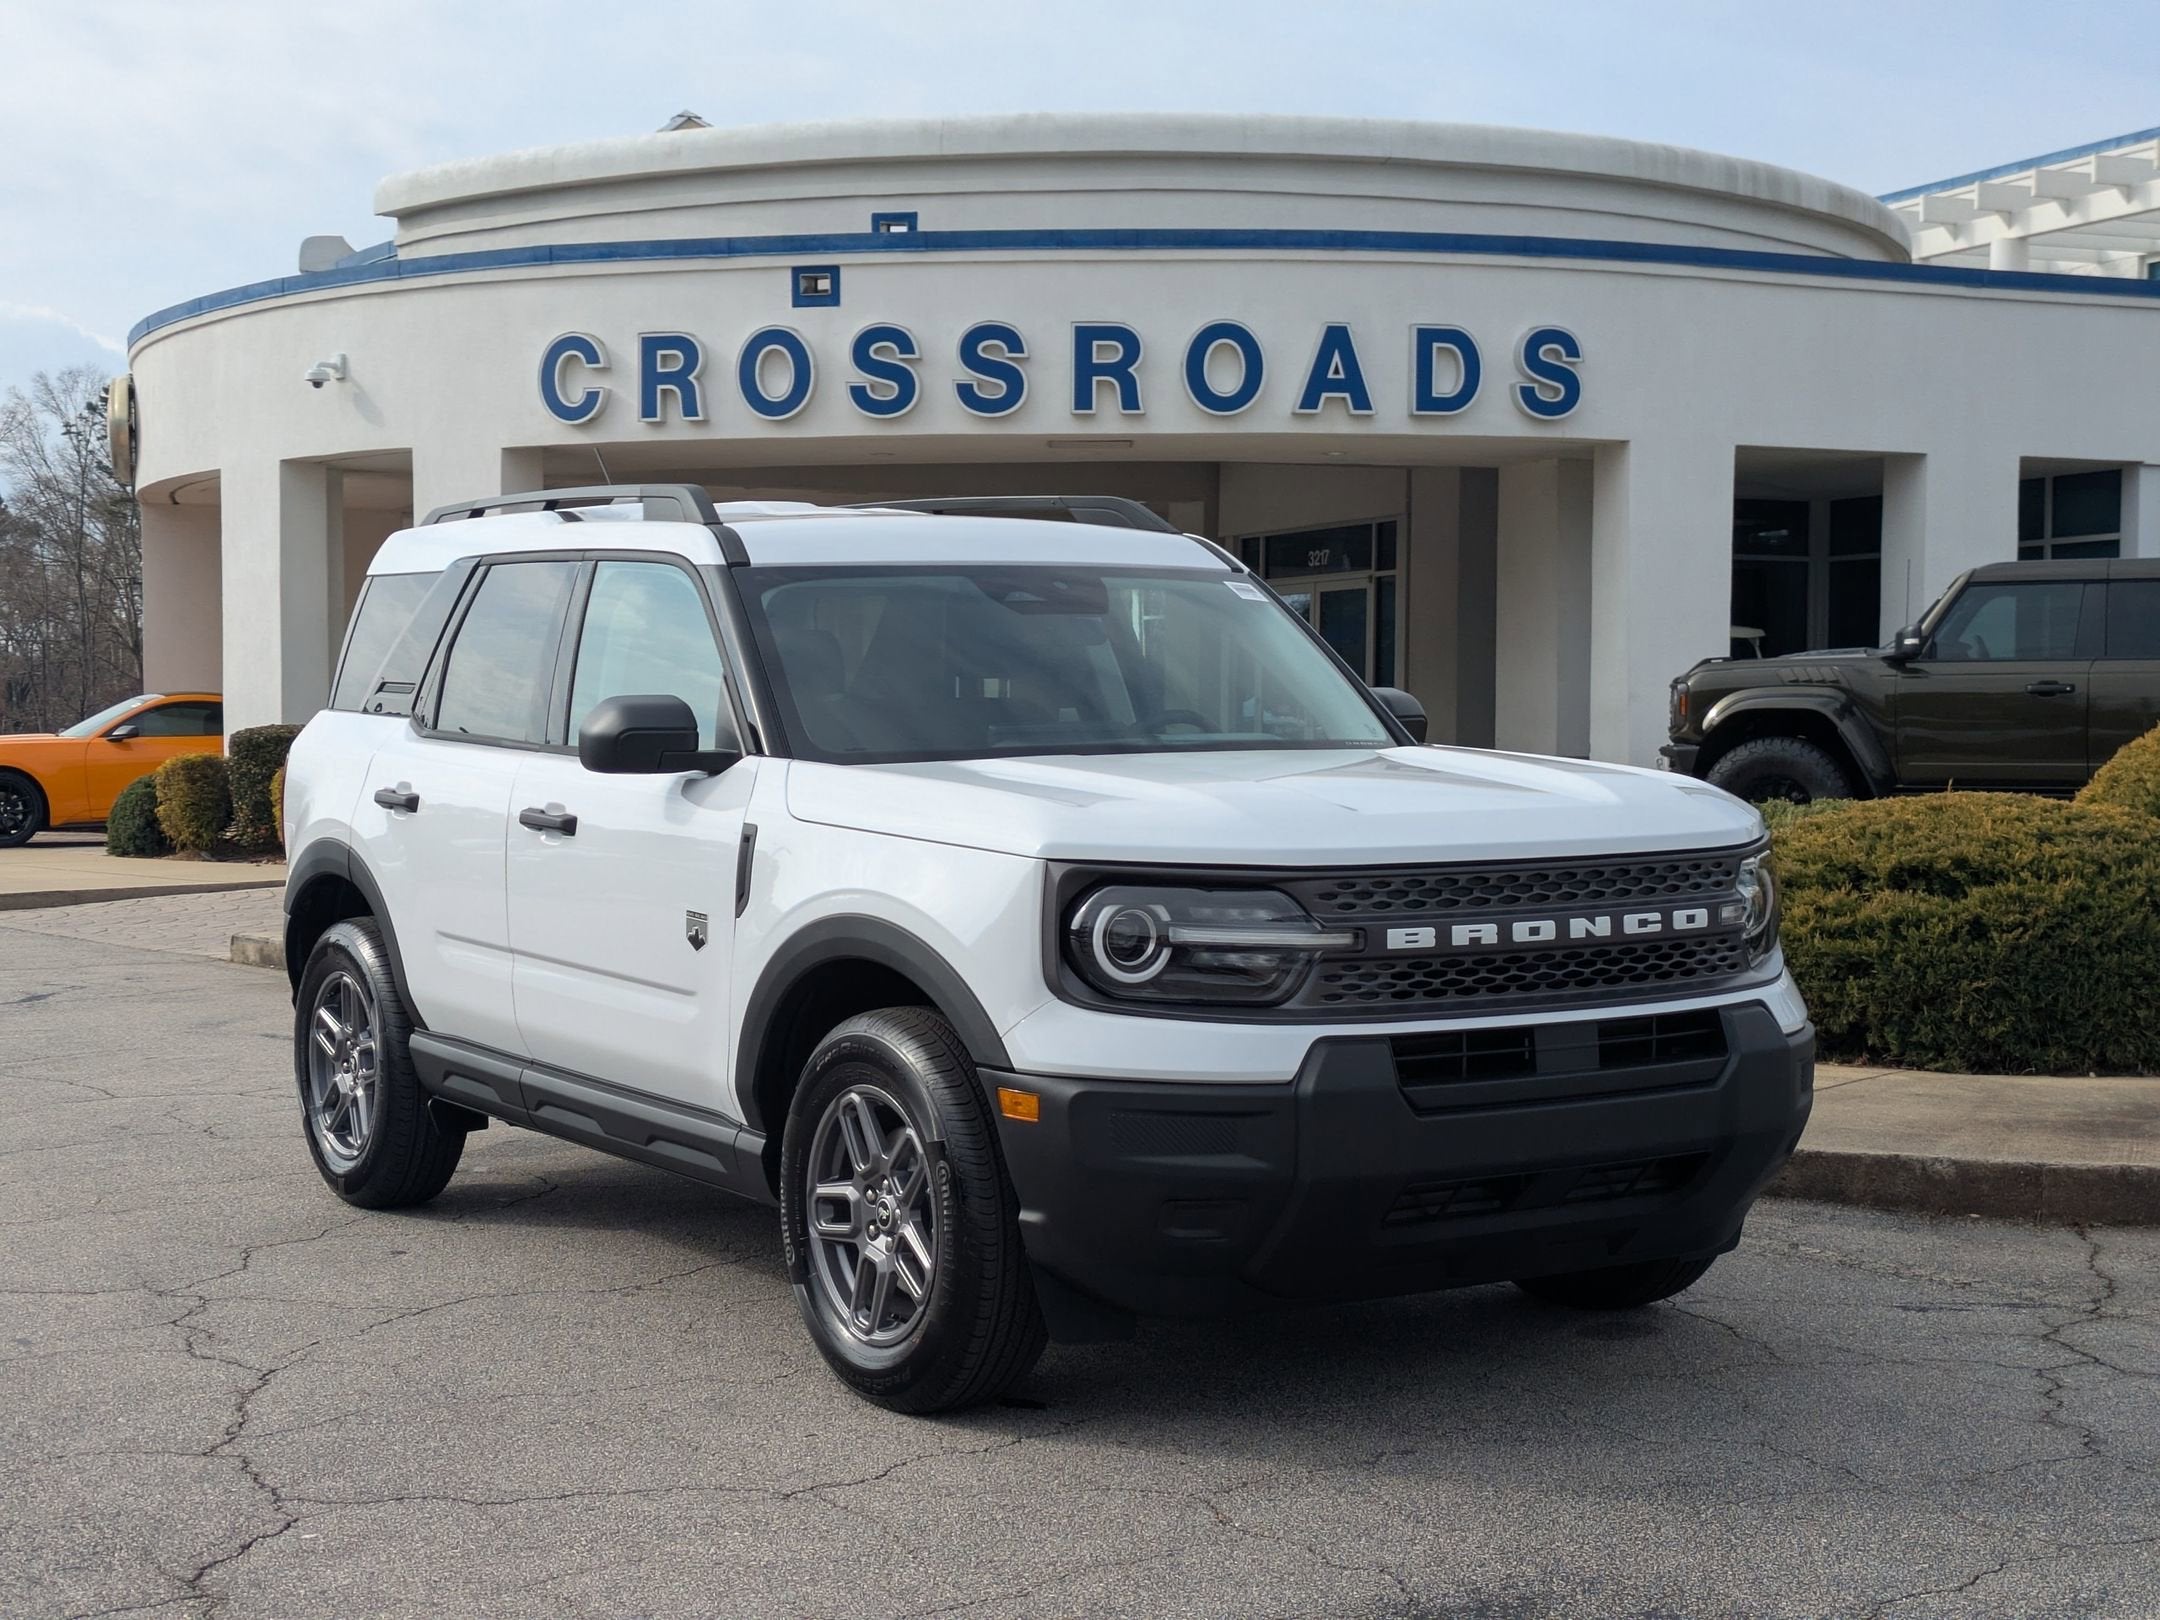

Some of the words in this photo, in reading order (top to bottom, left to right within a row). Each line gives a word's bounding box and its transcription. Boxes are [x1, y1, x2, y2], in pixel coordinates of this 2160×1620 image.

[538, 319, 1584, 425] CROSSROADS
[1308, 549, 1330, 567] 3217
[1386, 908, 1708, 949] BRONCO
